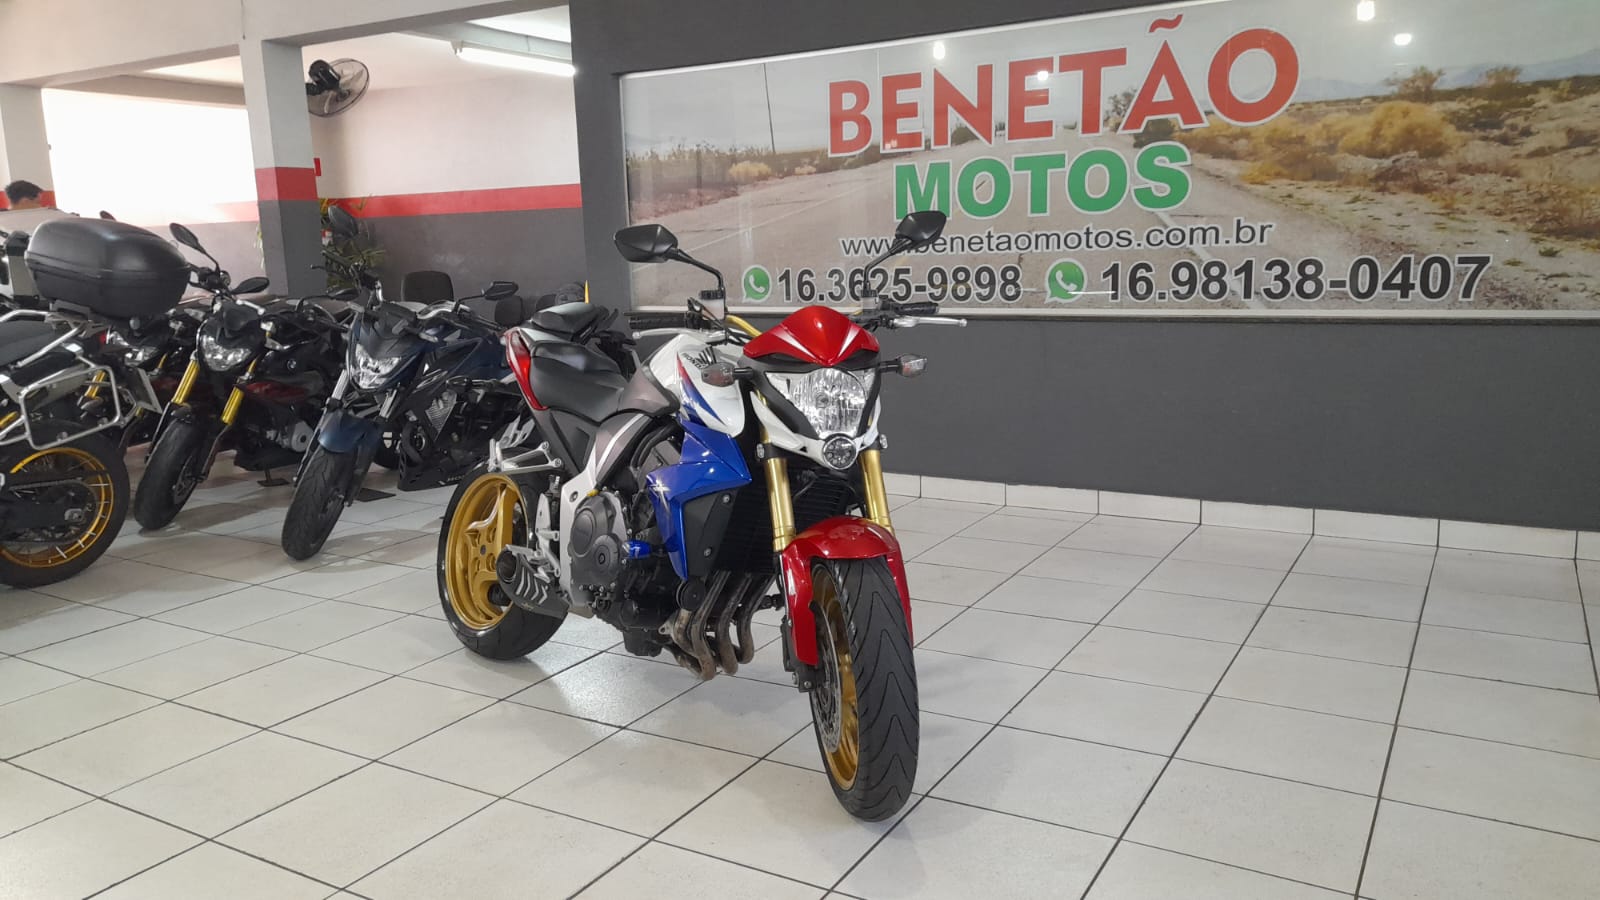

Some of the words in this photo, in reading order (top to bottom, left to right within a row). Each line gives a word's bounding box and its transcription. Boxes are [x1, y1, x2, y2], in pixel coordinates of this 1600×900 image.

[828, 14, 1300, 157] BENETÃO
[895, 144, 1191, 221] MOTOS
[841, 219, 1273, 255] ww.enetaomotos.com.br
[778, 265, 1022, 302] 16.3625-9898
[1102, 255, 1491, 301] 16.98138-0407
